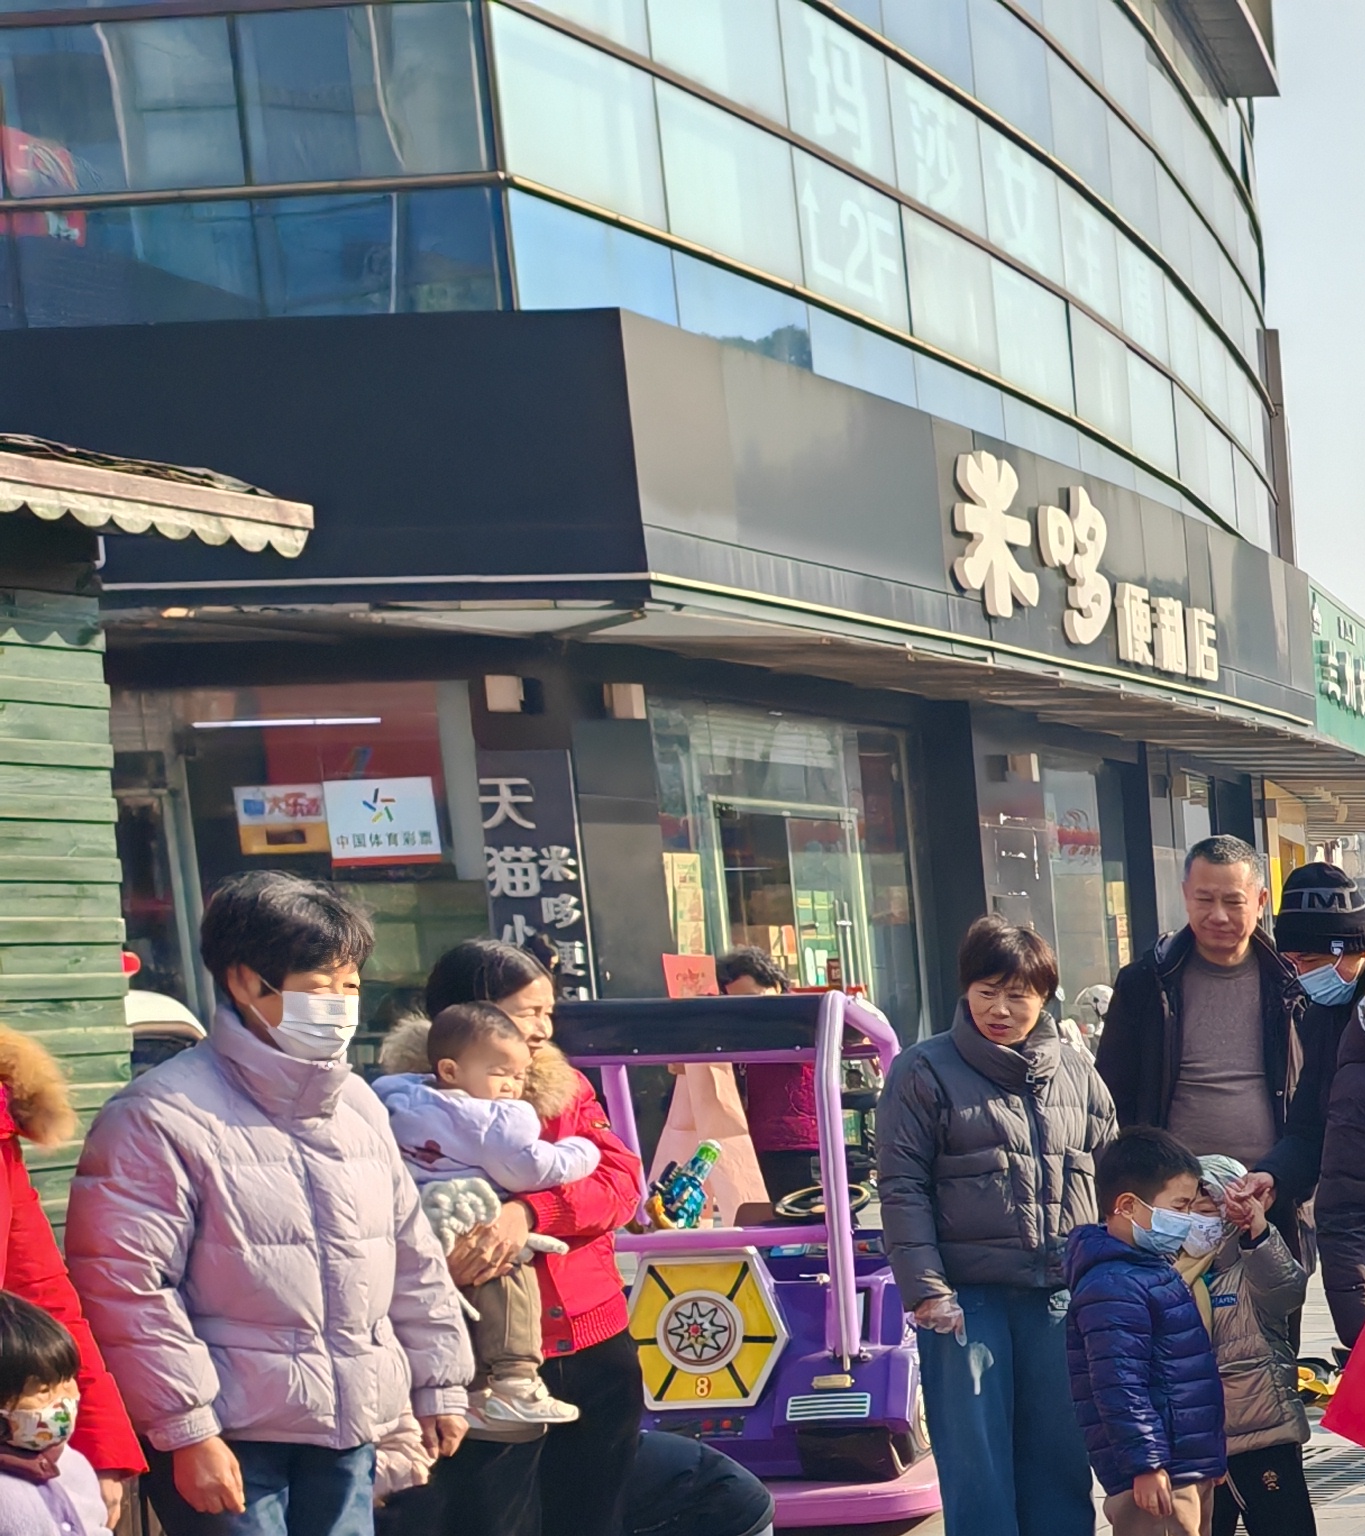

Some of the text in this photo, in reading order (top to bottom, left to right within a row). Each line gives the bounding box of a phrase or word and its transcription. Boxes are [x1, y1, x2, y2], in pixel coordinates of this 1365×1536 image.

[839, 198, 901, 310] 2F
[953, 449, 1221, 682] 米哆便利店
[335, 829, 434, 850] 中国体育彩票
[695, 1375, 711, 1398] 8
